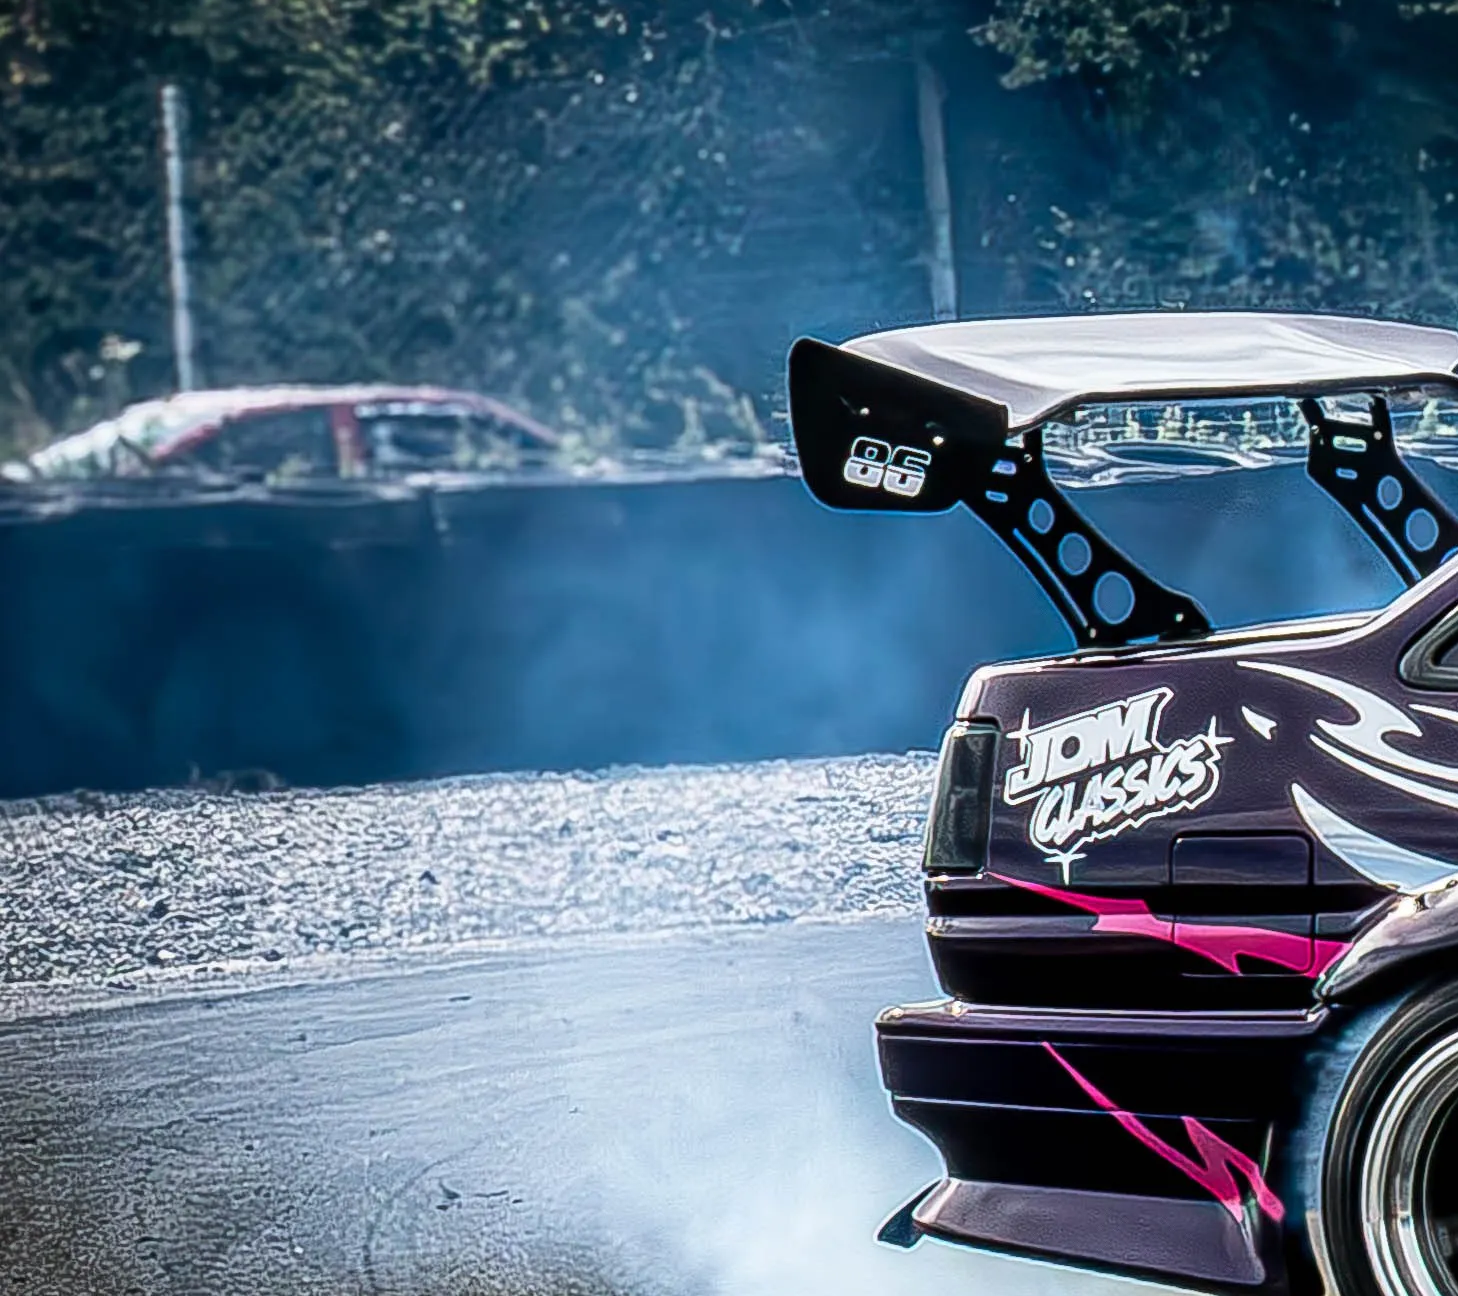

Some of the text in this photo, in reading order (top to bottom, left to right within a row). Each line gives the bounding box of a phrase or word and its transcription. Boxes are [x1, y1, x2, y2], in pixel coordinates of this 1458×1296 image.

[843, 436, 932, 497] 86
[1008, 693, 1160, 795] JDM
[1033, 741, 1207, 845] CLASSICS
